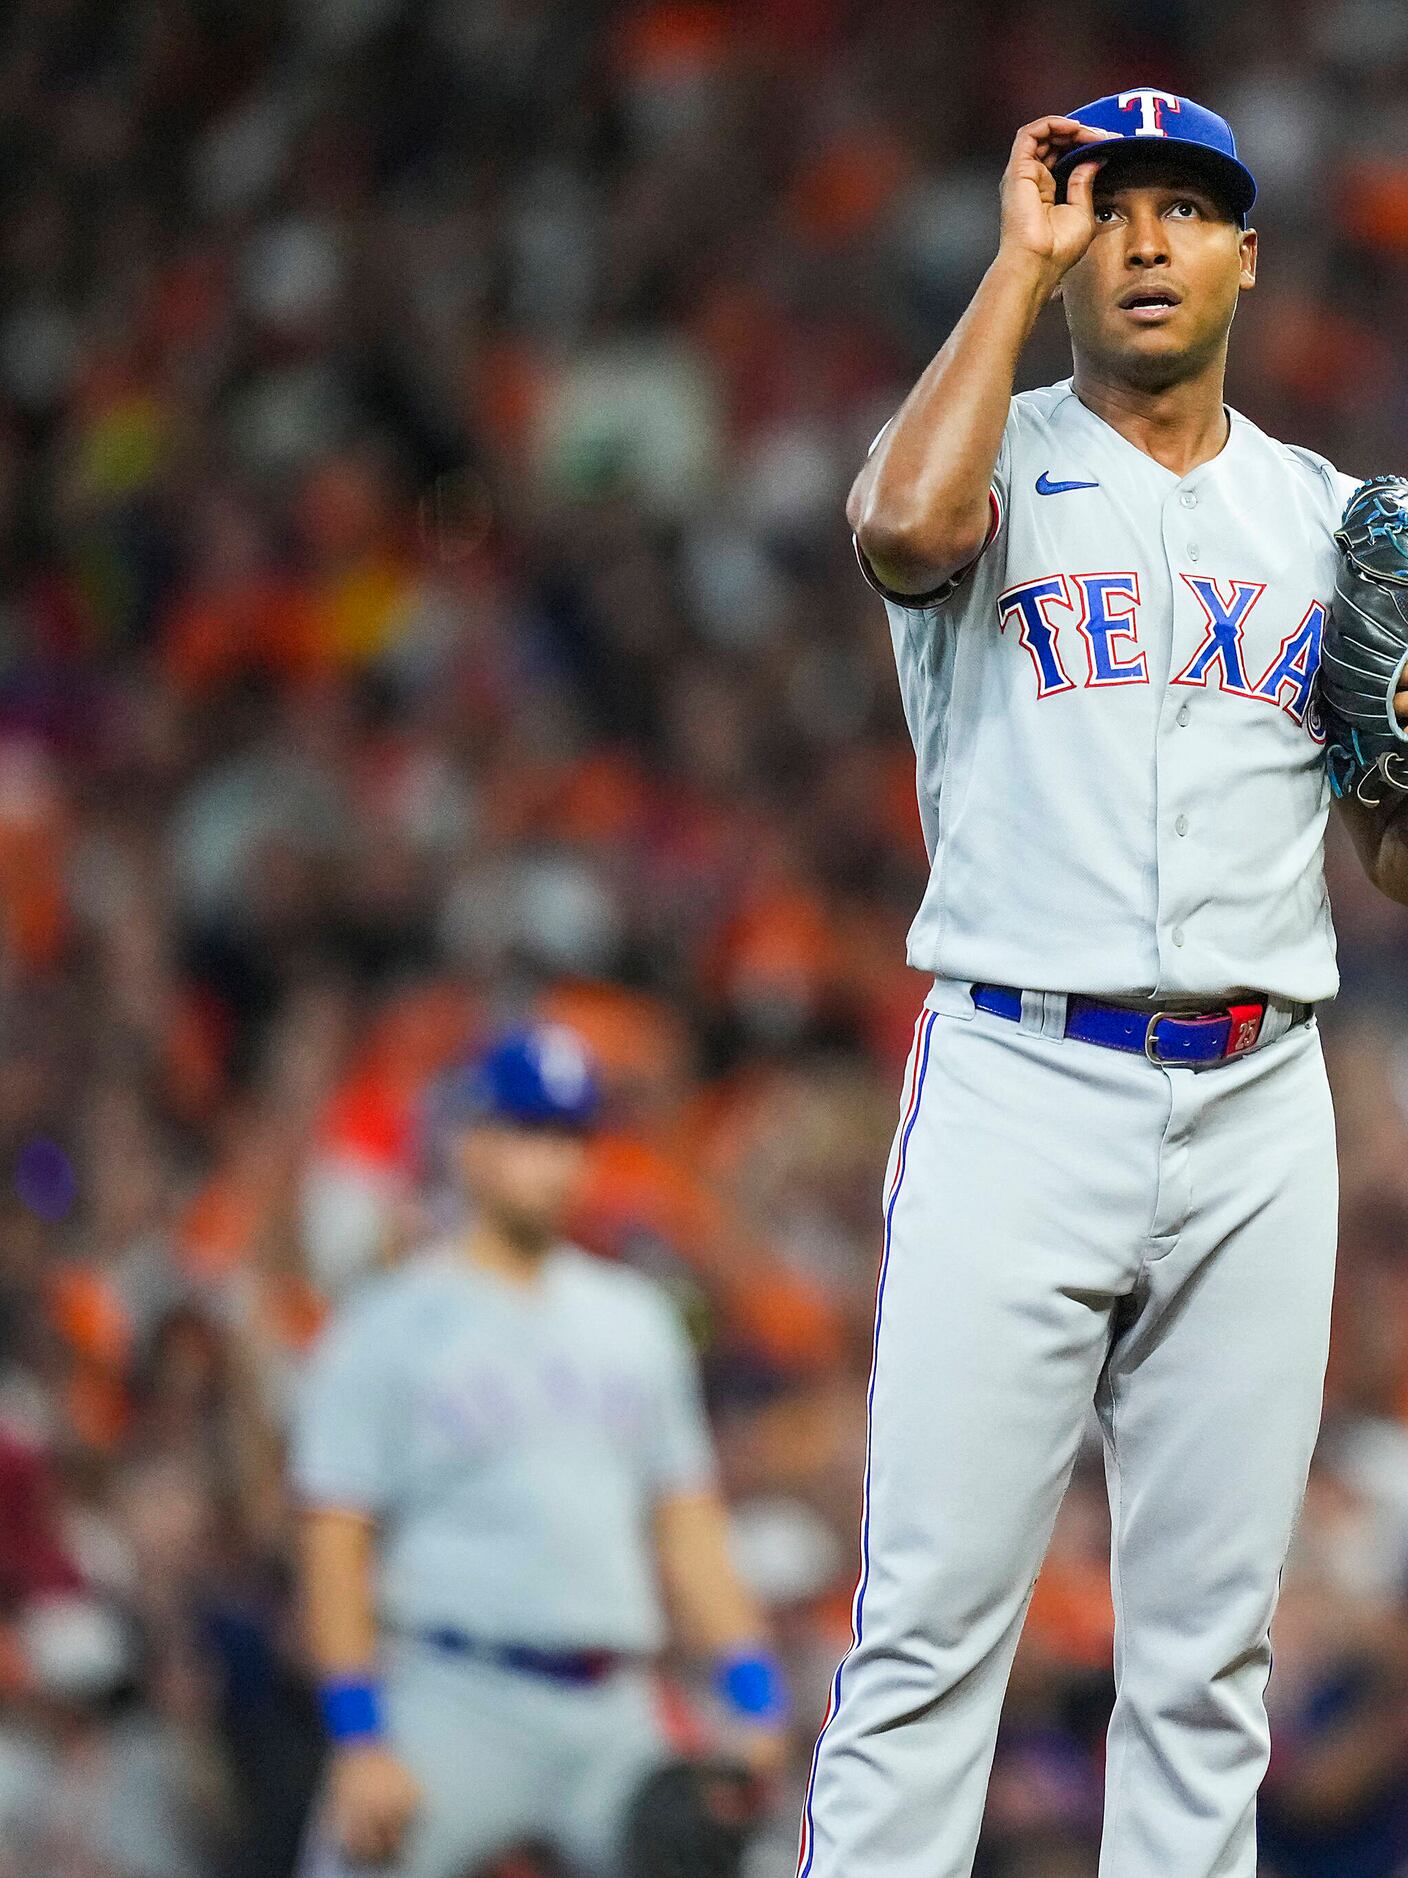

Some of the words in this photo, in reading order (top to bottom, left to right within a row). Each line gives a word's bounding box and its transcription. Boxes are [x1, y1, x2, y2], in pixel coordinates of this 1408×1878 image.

[1118, 91, 1180, 137] T
[997, 572, 1328, 745] TEXA
[1235, 1018, 1257, 1050] 25
